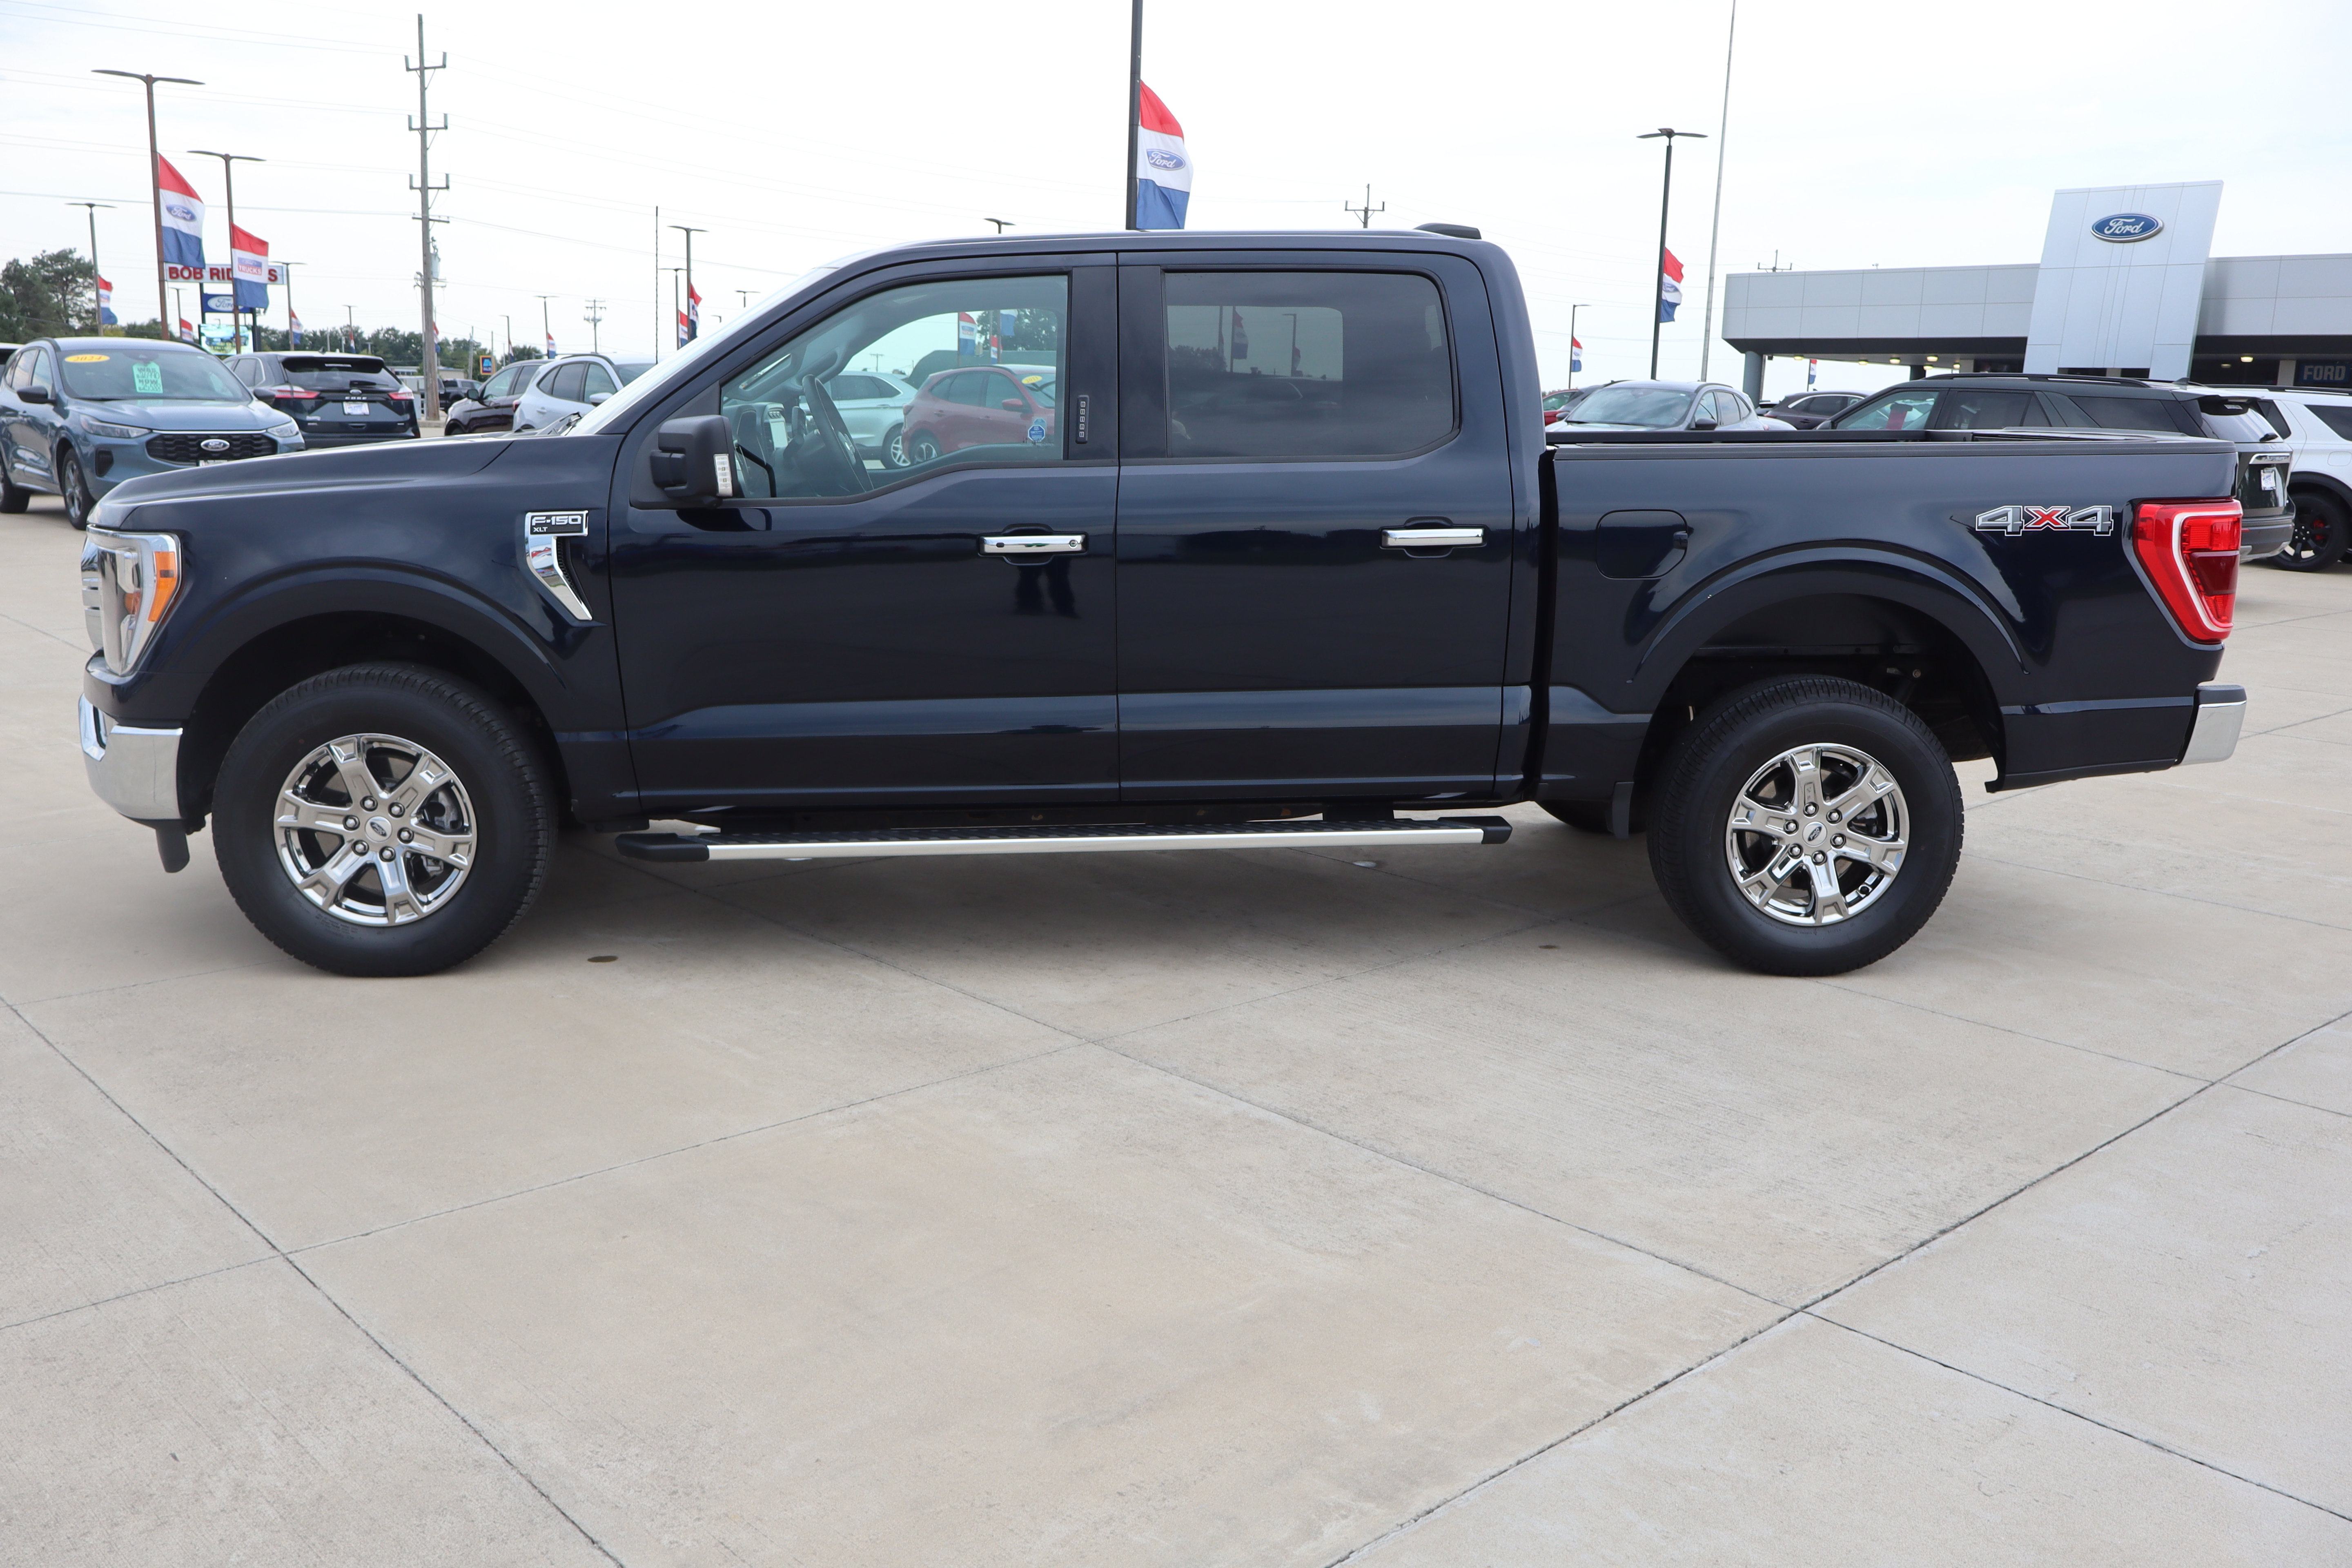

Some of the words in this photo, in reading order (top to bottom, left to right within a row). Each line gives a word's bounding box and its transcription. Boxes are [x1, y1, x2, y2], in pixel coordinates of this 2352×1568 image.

[1149, 151, 1177, 168] Ford
[171, 206, 191, 220] Ford
[2104, 218, 2145, 234] Ford
[169, 266, 203, 280] BOB
[210, 267, 278, 281] RIDS
[238, 265, 261, 275] TRUCKS
[215, 298, 233, 307] For
[2303, 365, 2345, 381] FORD
[532, 515, 581, 526] F-150
